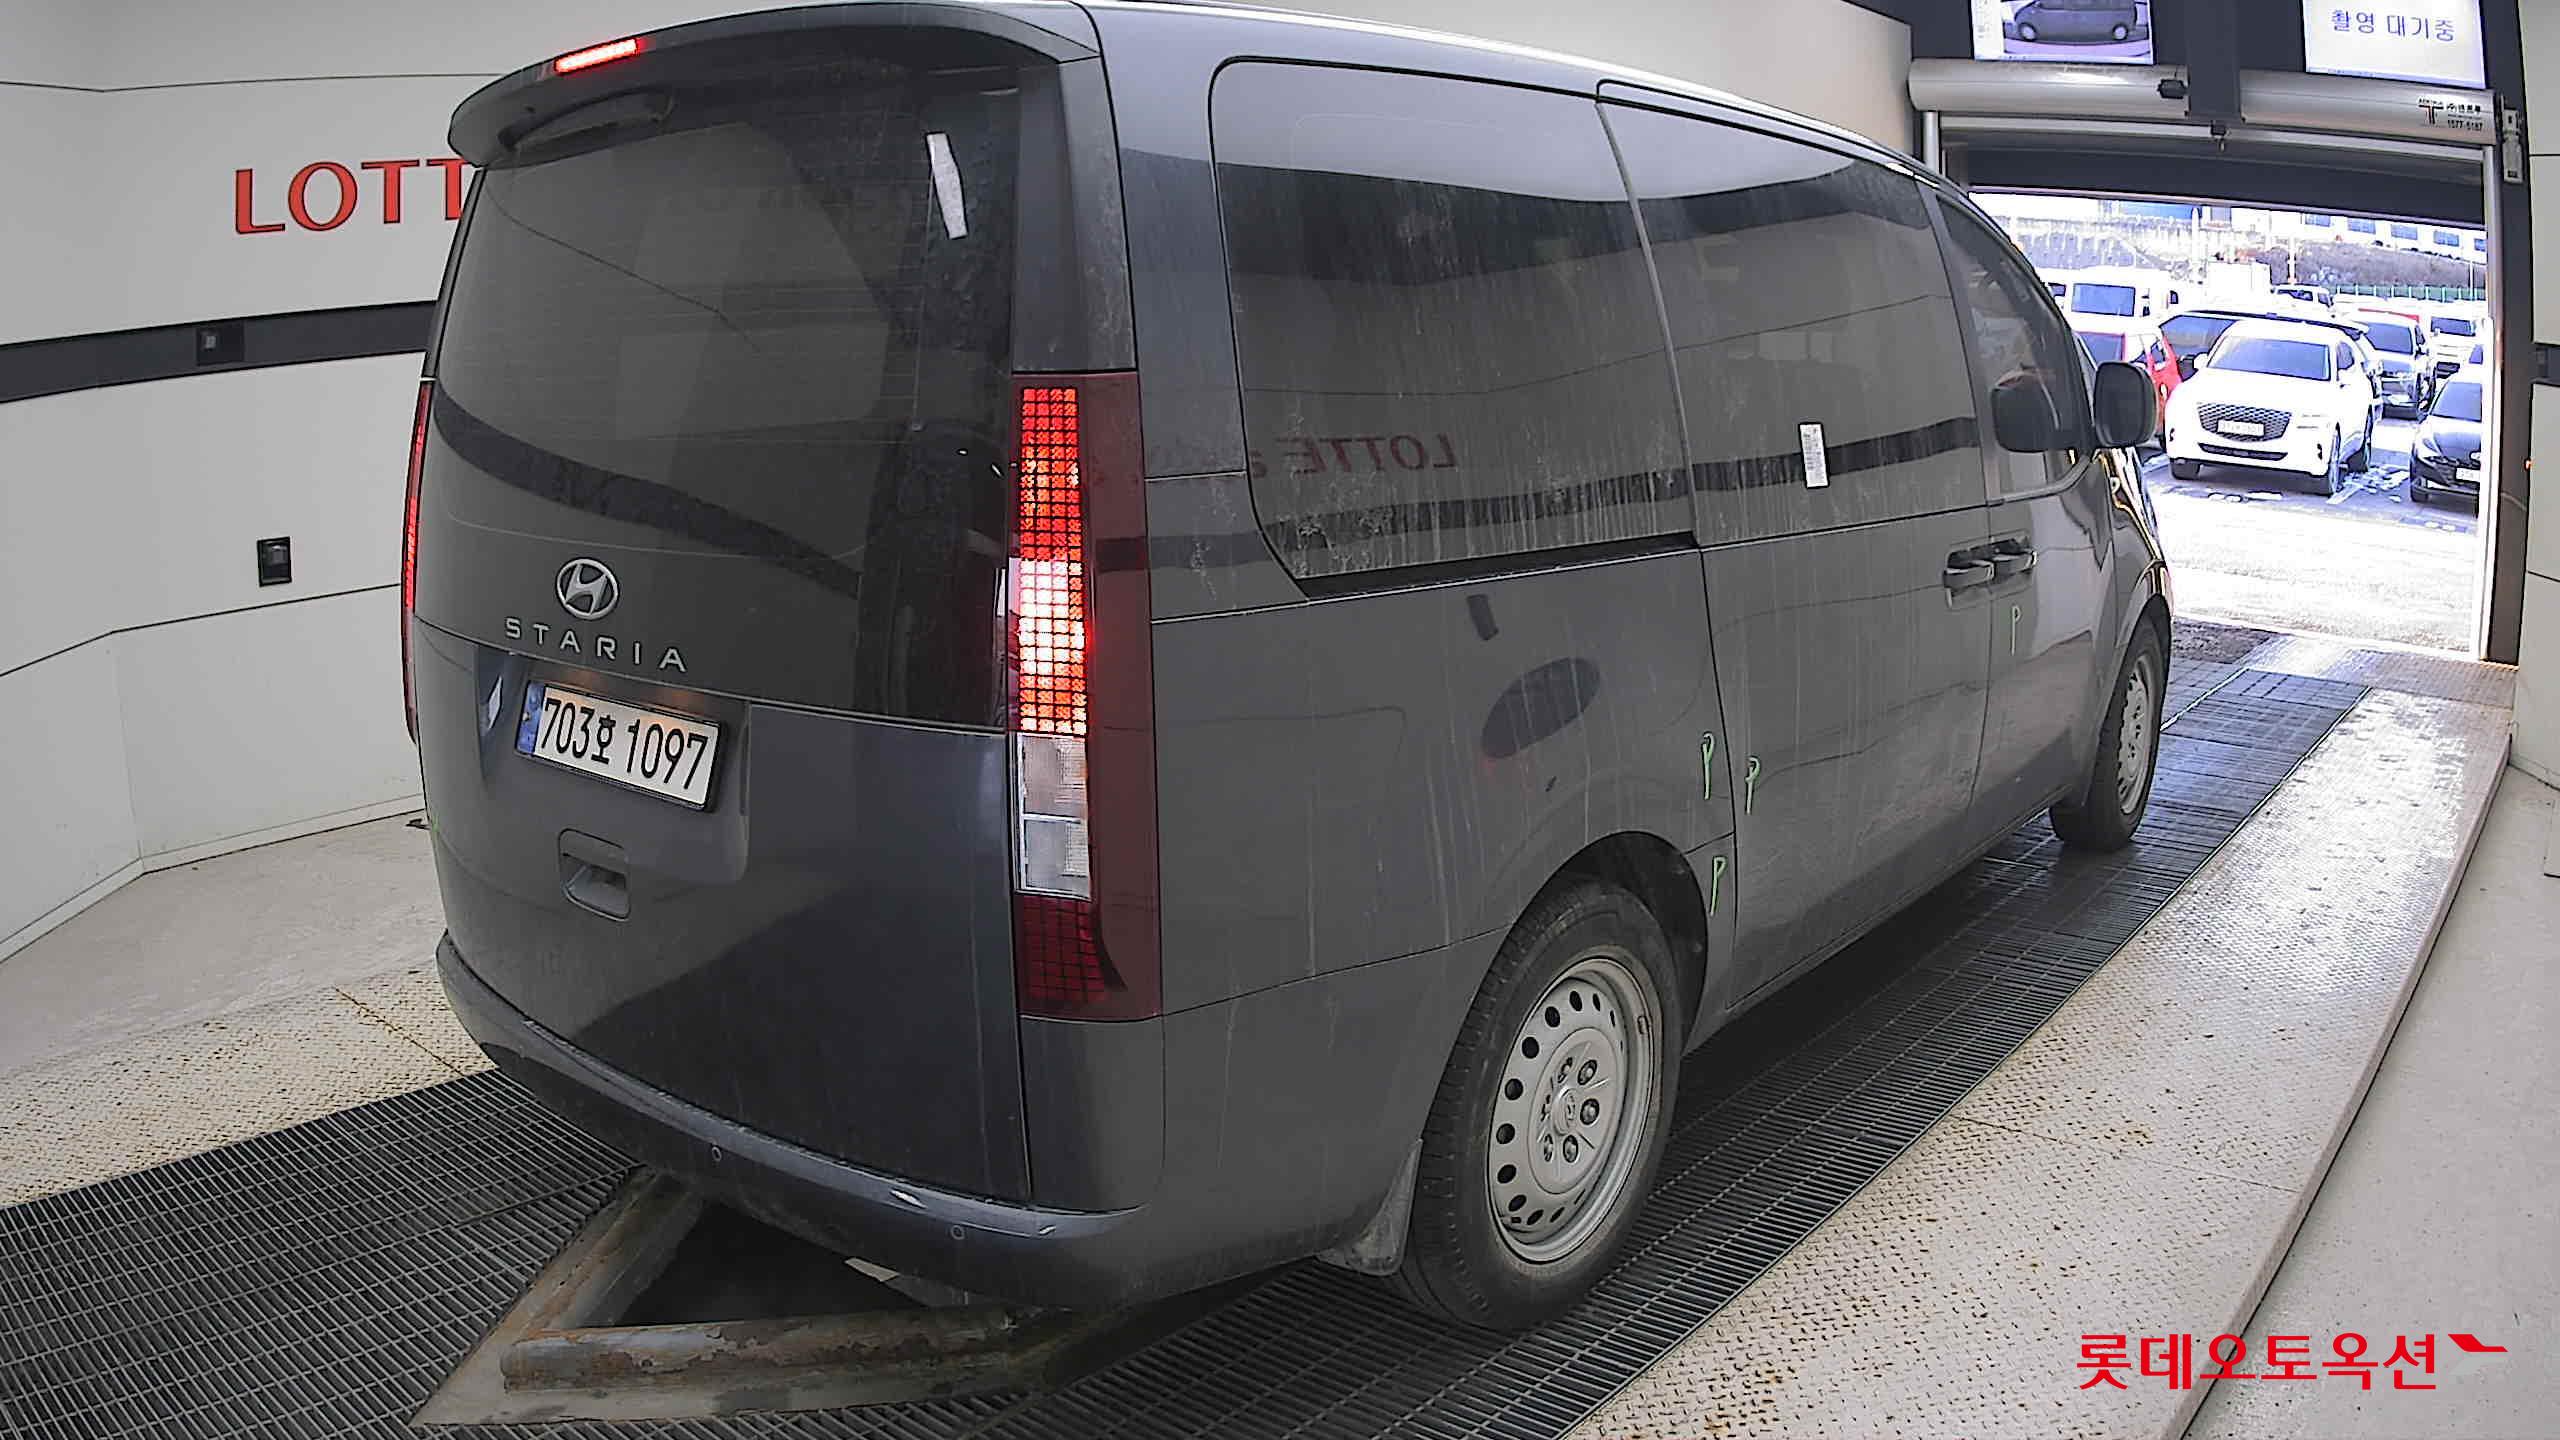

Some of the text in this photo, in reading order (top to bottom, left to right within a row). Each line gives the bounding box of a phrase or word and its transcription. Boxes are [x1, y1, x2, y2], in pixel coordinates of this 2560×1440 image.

[2331, 9, 2455, 42] 촬영 대기중
[505, 617, 688, 673] STARIA
[541, 696, 709, 790] 703호 1097
